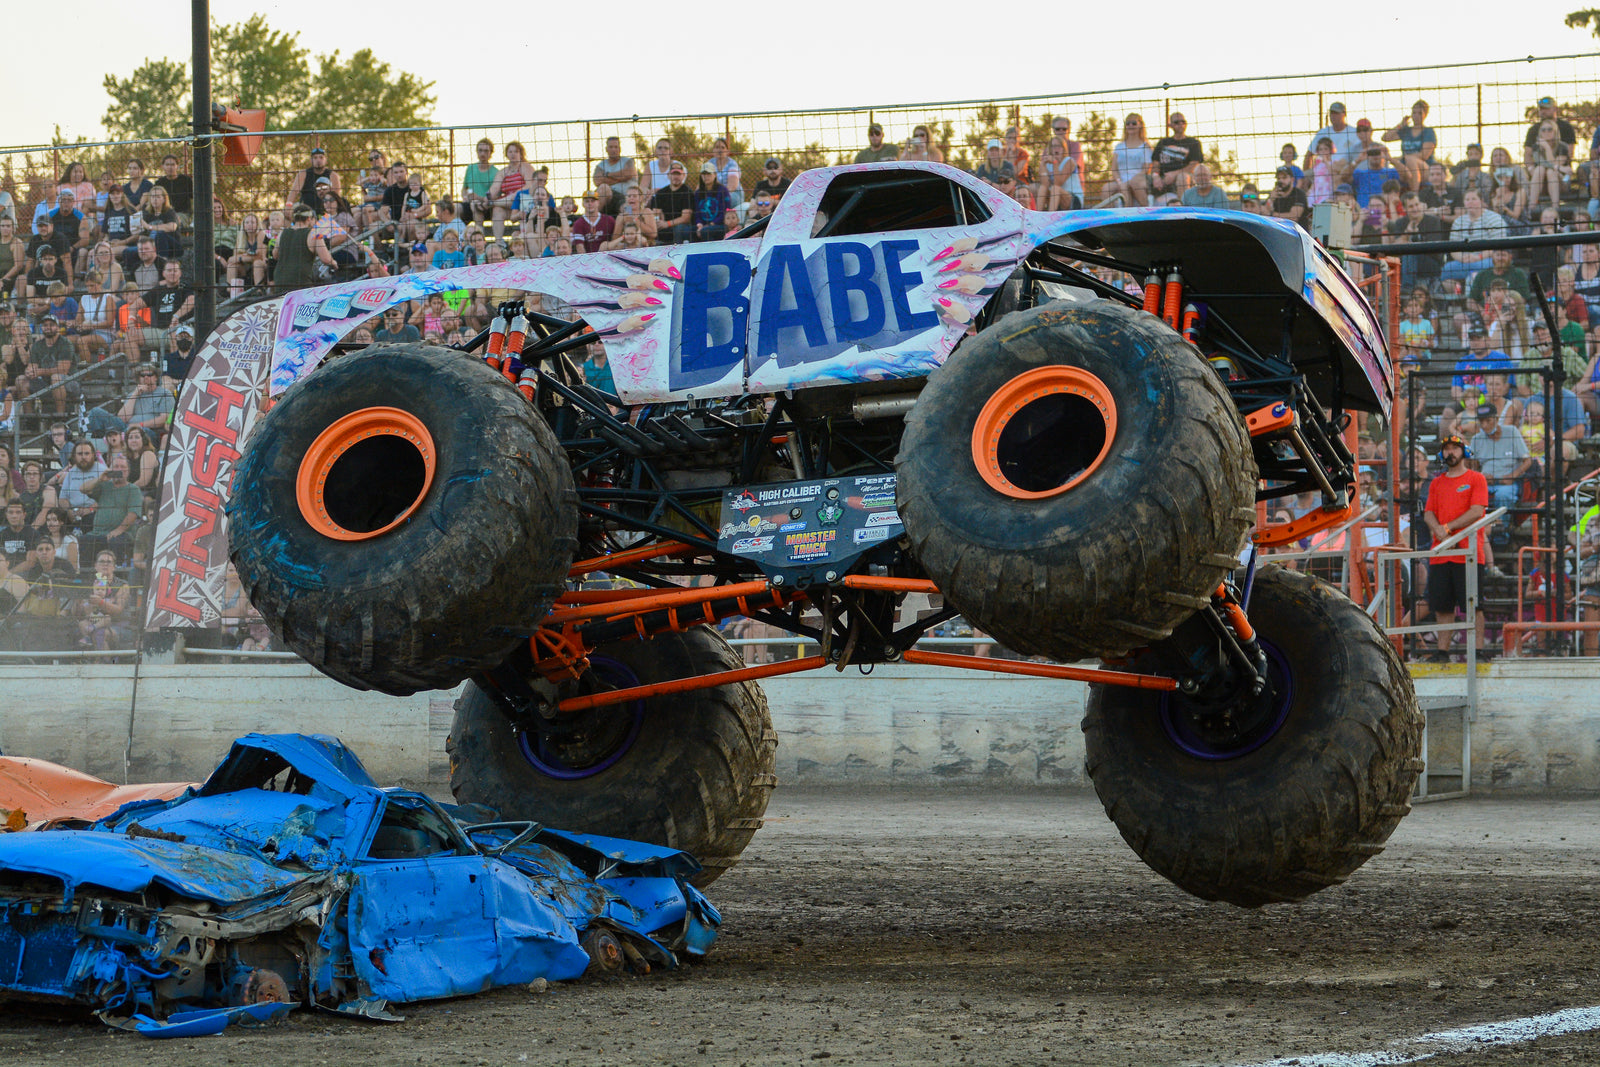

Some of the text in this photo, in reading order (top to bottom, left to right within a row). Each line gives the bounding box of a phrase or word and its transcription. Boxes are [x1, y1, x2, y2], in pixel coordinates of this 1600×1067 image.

[161, 293, 175, 304] 45
[359, 289, 387, 303] RED
[678, 238, 941, 376] BABE
[219, 341, 272, 353] North Star
[229, 351, 260, 360] Ranch
[234, 360, 252, 368] Inc.
[759, 485, 821, 501] HIGH CALIBER
[155, 380, 246, 622] FINISH
[786, 529, 836, 545] MONSTER
[793, 542, 827, 555] TRUCK
